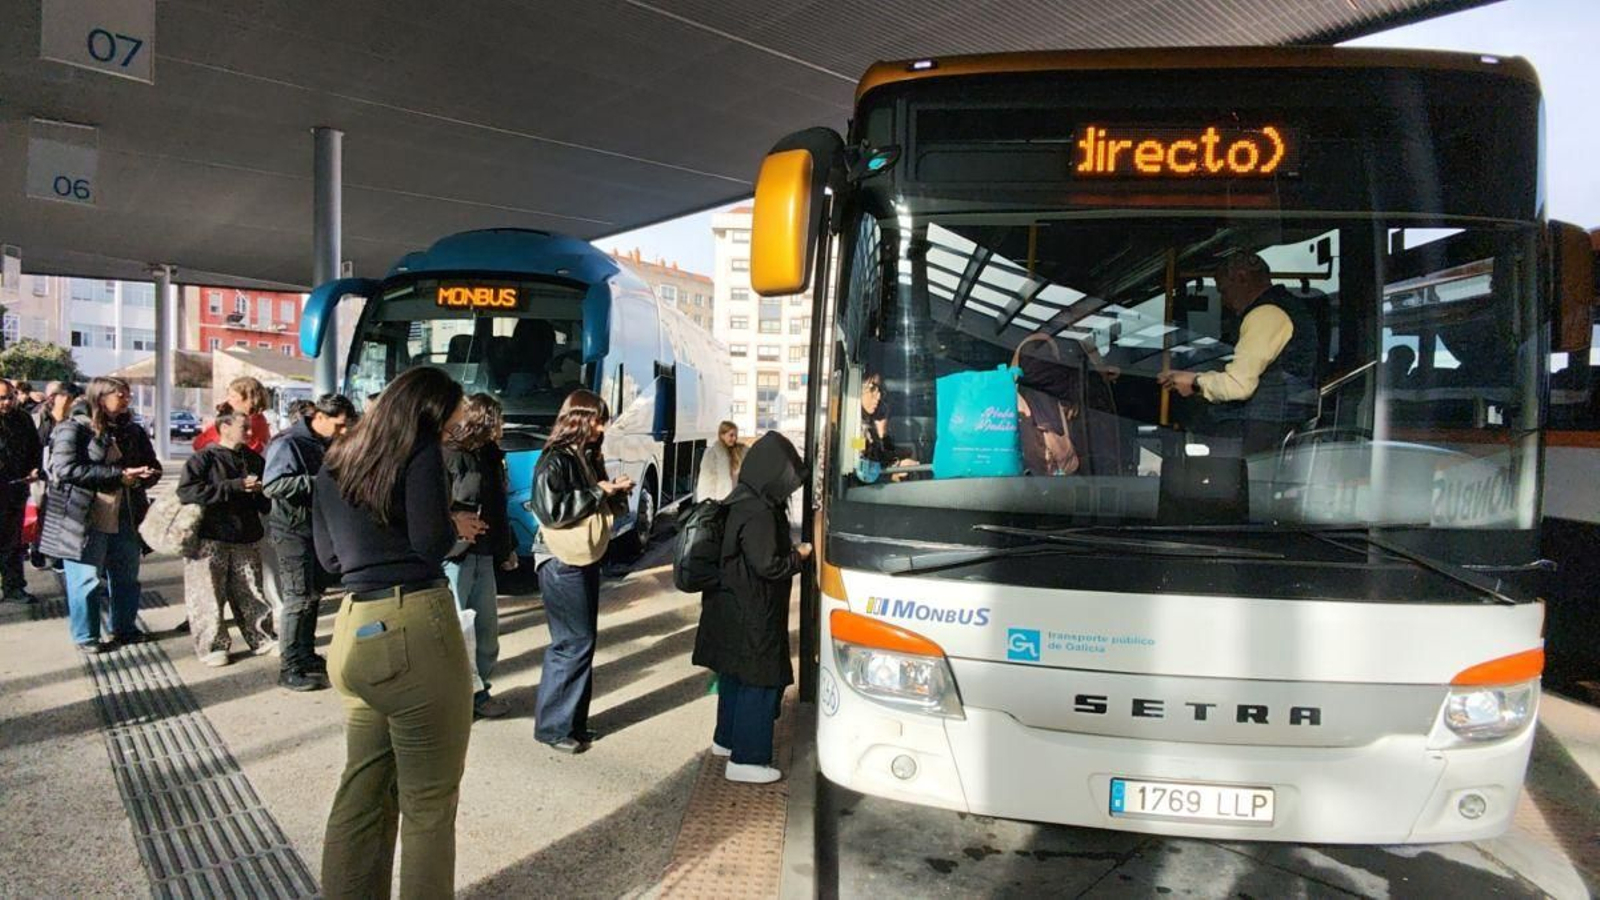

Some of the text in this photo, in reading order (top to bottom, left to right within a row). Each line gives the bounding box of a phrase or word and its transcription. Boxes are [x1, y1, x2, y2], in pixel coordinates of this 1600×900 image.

[87, 28, 143, 67] 07
[53, 176, 91, 200] 06
[437, 287, 517, 307] MONBUS
[1047, 631, 1108, 643] transporte
[1047, 641, 1106, 653] de Galicia
[1073, 694, 1322, 726] SETRA
[1138, 786, 1268, 818] 1769 LLP
